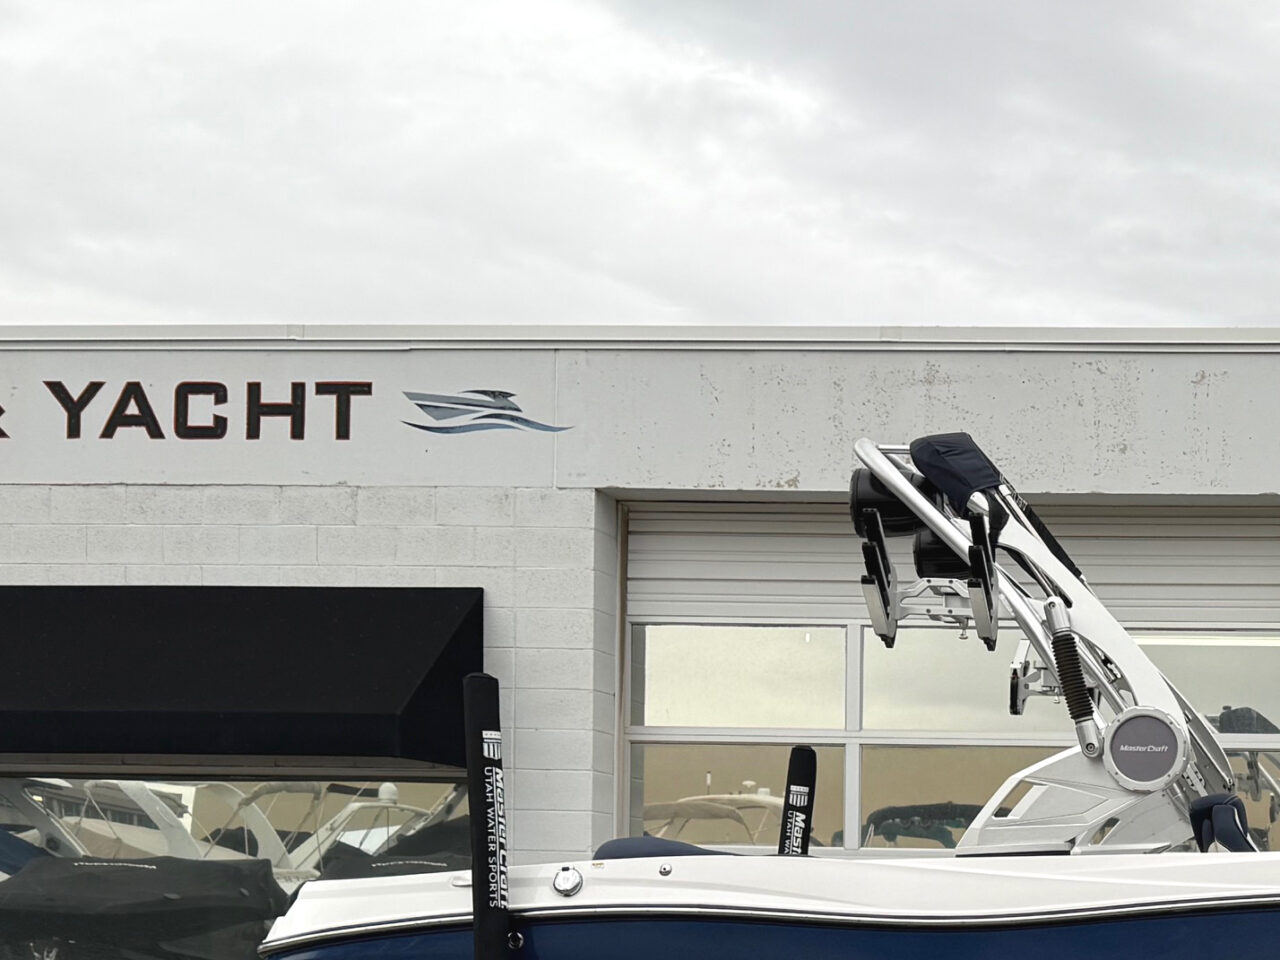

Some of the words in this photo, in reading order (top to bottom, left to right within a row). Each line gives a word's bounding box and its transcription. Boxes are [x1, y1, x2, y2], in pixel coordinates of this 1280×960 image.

[43, 381, 373, 440] YACHT
[484, 767, 494, 802] UTAH
[486, 808, 496, 851] WATER
[487, 857, 498, 908] SPORTS
